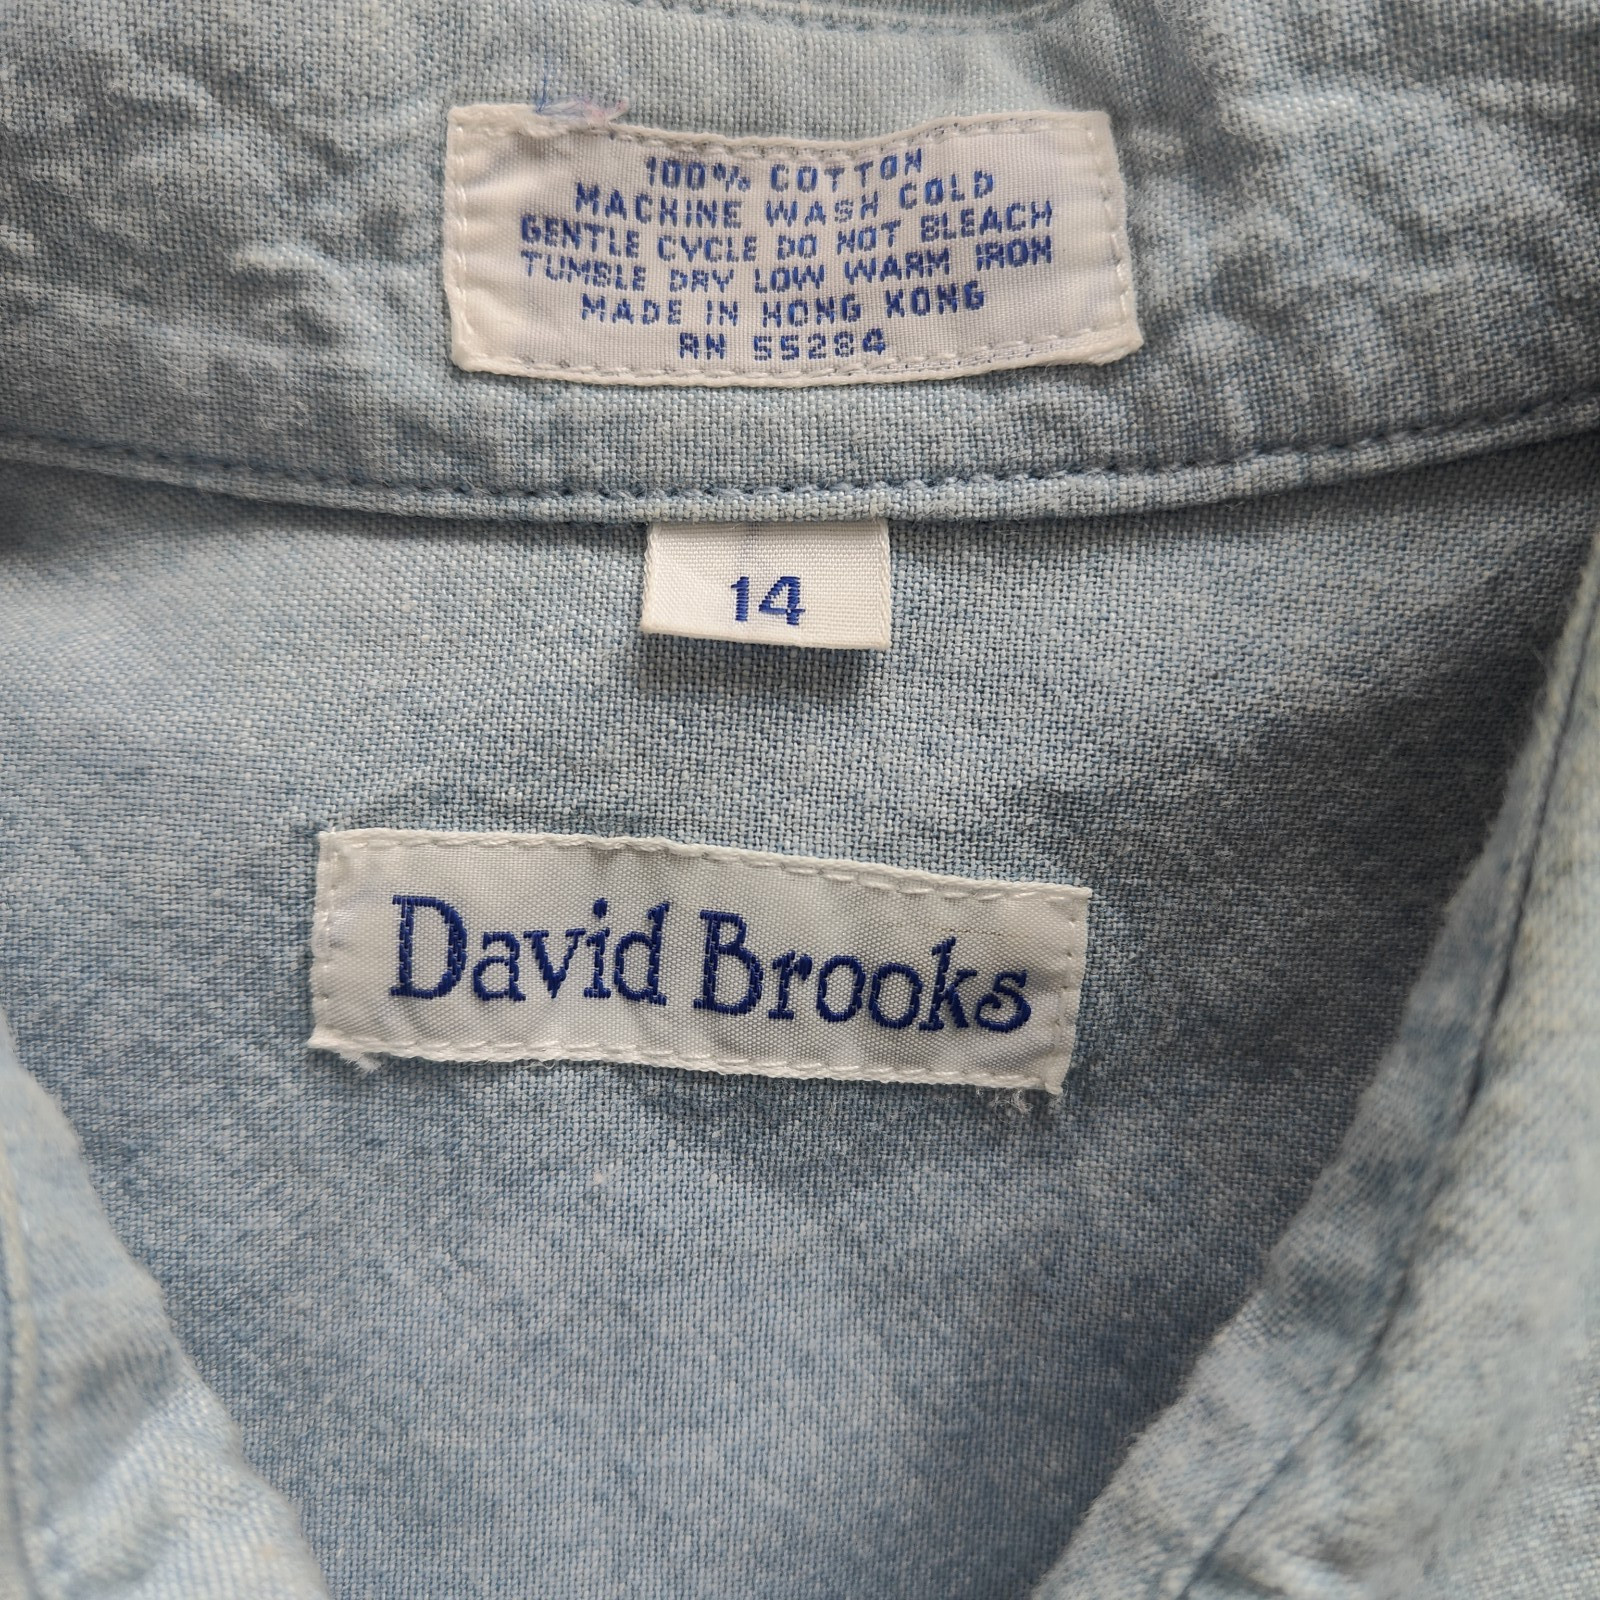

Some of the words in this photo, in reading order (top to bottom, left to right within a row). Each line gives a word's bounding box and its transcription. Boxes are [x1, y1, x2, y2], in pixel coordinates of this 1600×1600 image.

[646, 155, 751, 192] 100%
[770, 148, 922, 193] COTTON
[575, 181, 742, 229] MACHINE
[765, 191, 878, 227] WASH
[900, 169, 994, 209] COLD
[521, 214, 640, 259] GENTLE
[658, 235, 757, 262] CYCLE
[777, 233, 817, 260] DO
[836, 218, 901, 255] NOT
[921, 201, 1052, 243] BLEACH
[521, 249, 646, 291] TUMBLE
[670, 268, 733, 292] DRY
[755, 264, 825, 294] LOW
[844, 247, 950, 285] WARM
[976, 235, 1052, 271] IRON
[581, 292, 683, 325] MADE
[706, 300, 739, 326] IN
[762, 293, 861, 328] HONG
[885, 280, 985, 318] KONG
[679, 332, 726, 360] RN
[730, 576, 806, 626] 14
[390, 894, 670, 1006] David
[693, 909, 1031, 1032] Brooks
